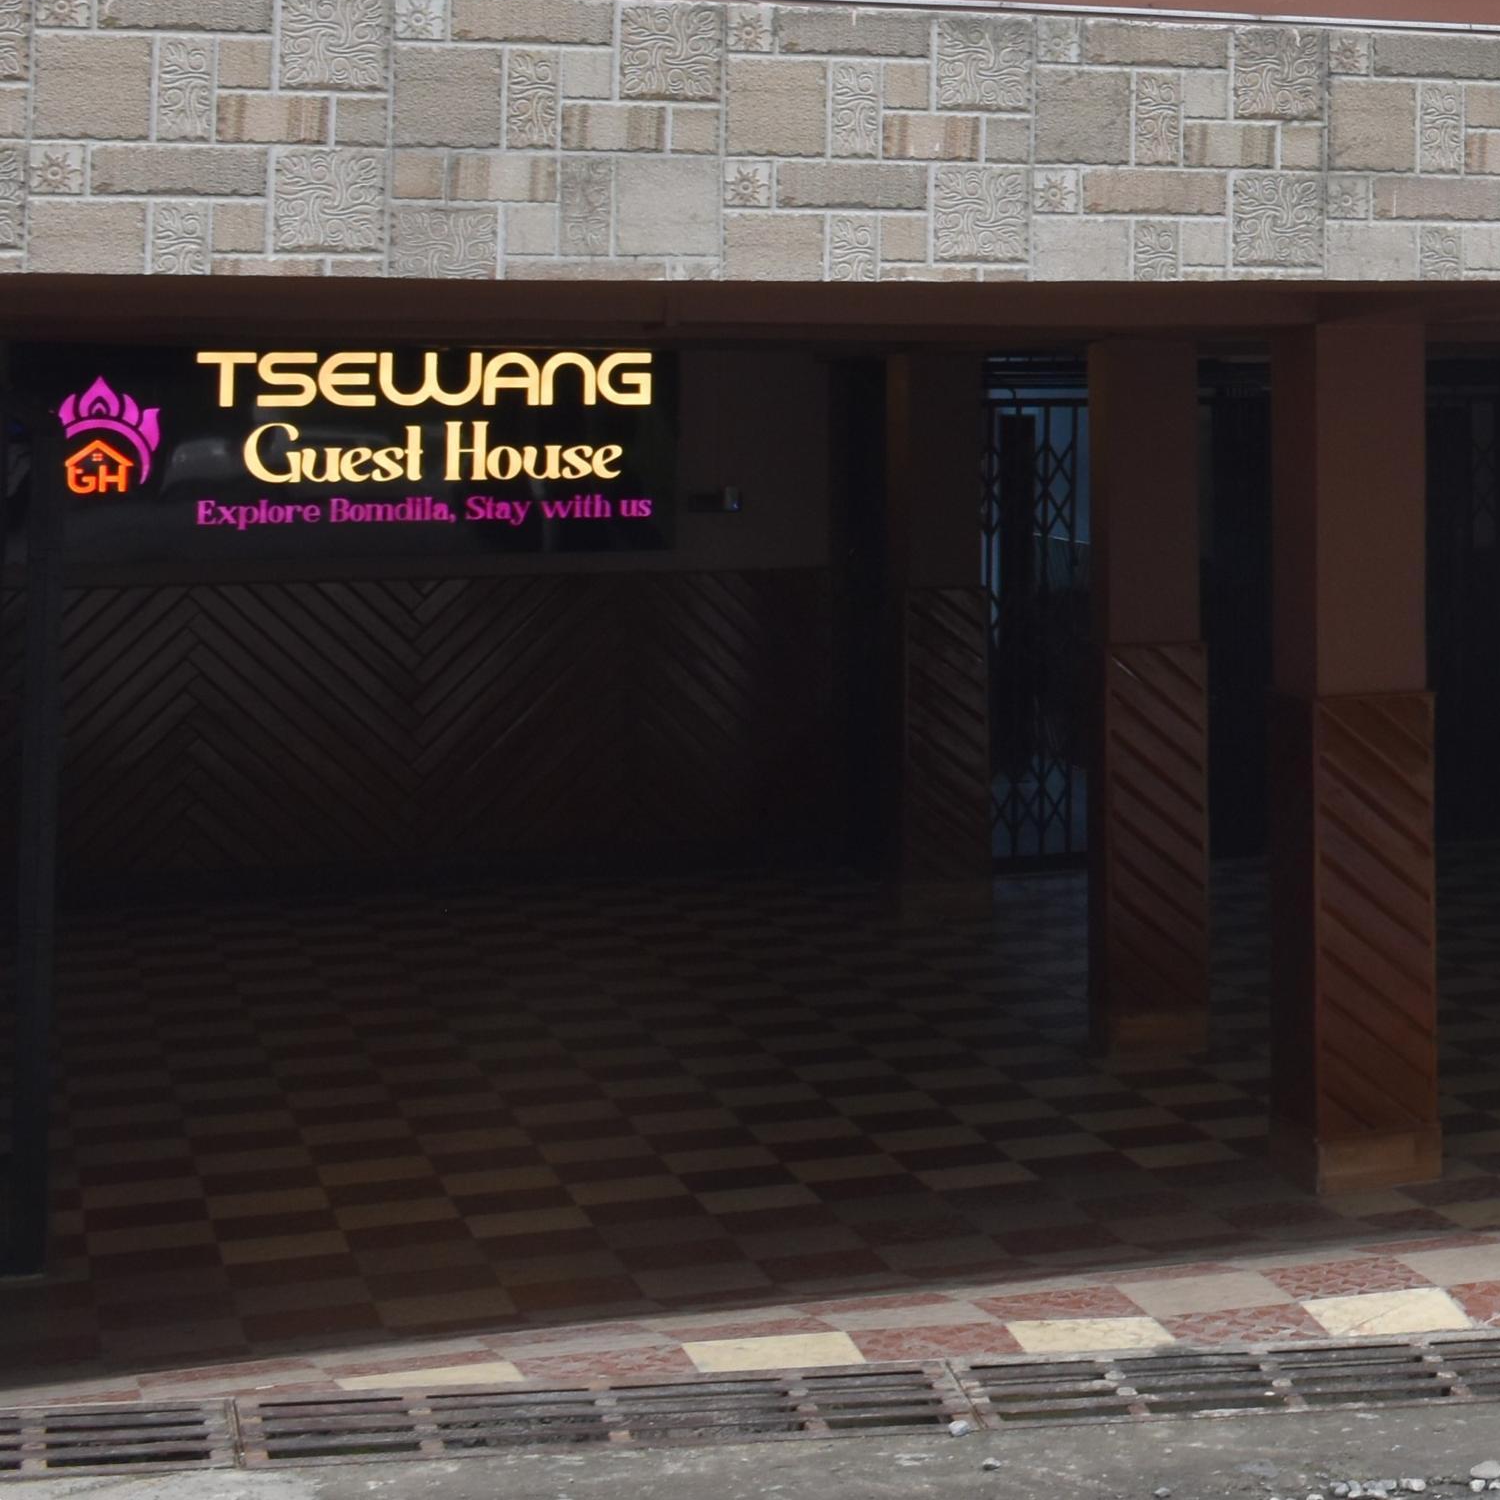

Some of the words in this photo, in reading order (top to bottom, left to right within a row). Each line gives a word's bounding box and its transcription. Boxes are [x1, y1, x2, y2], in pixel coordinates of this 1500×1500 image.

[196, 351, 652, 407] TSEWANG
[243, 422, 423, 483] Guest
[444, 420, 623, 481] House
[197, 499, 320, 530] Explore
[330, 496, 456, 523] Bomdila,
[466, 496, 529, 526] Stay
[542, 494, 611, 519] with
[620, 499, 652, 518] us
